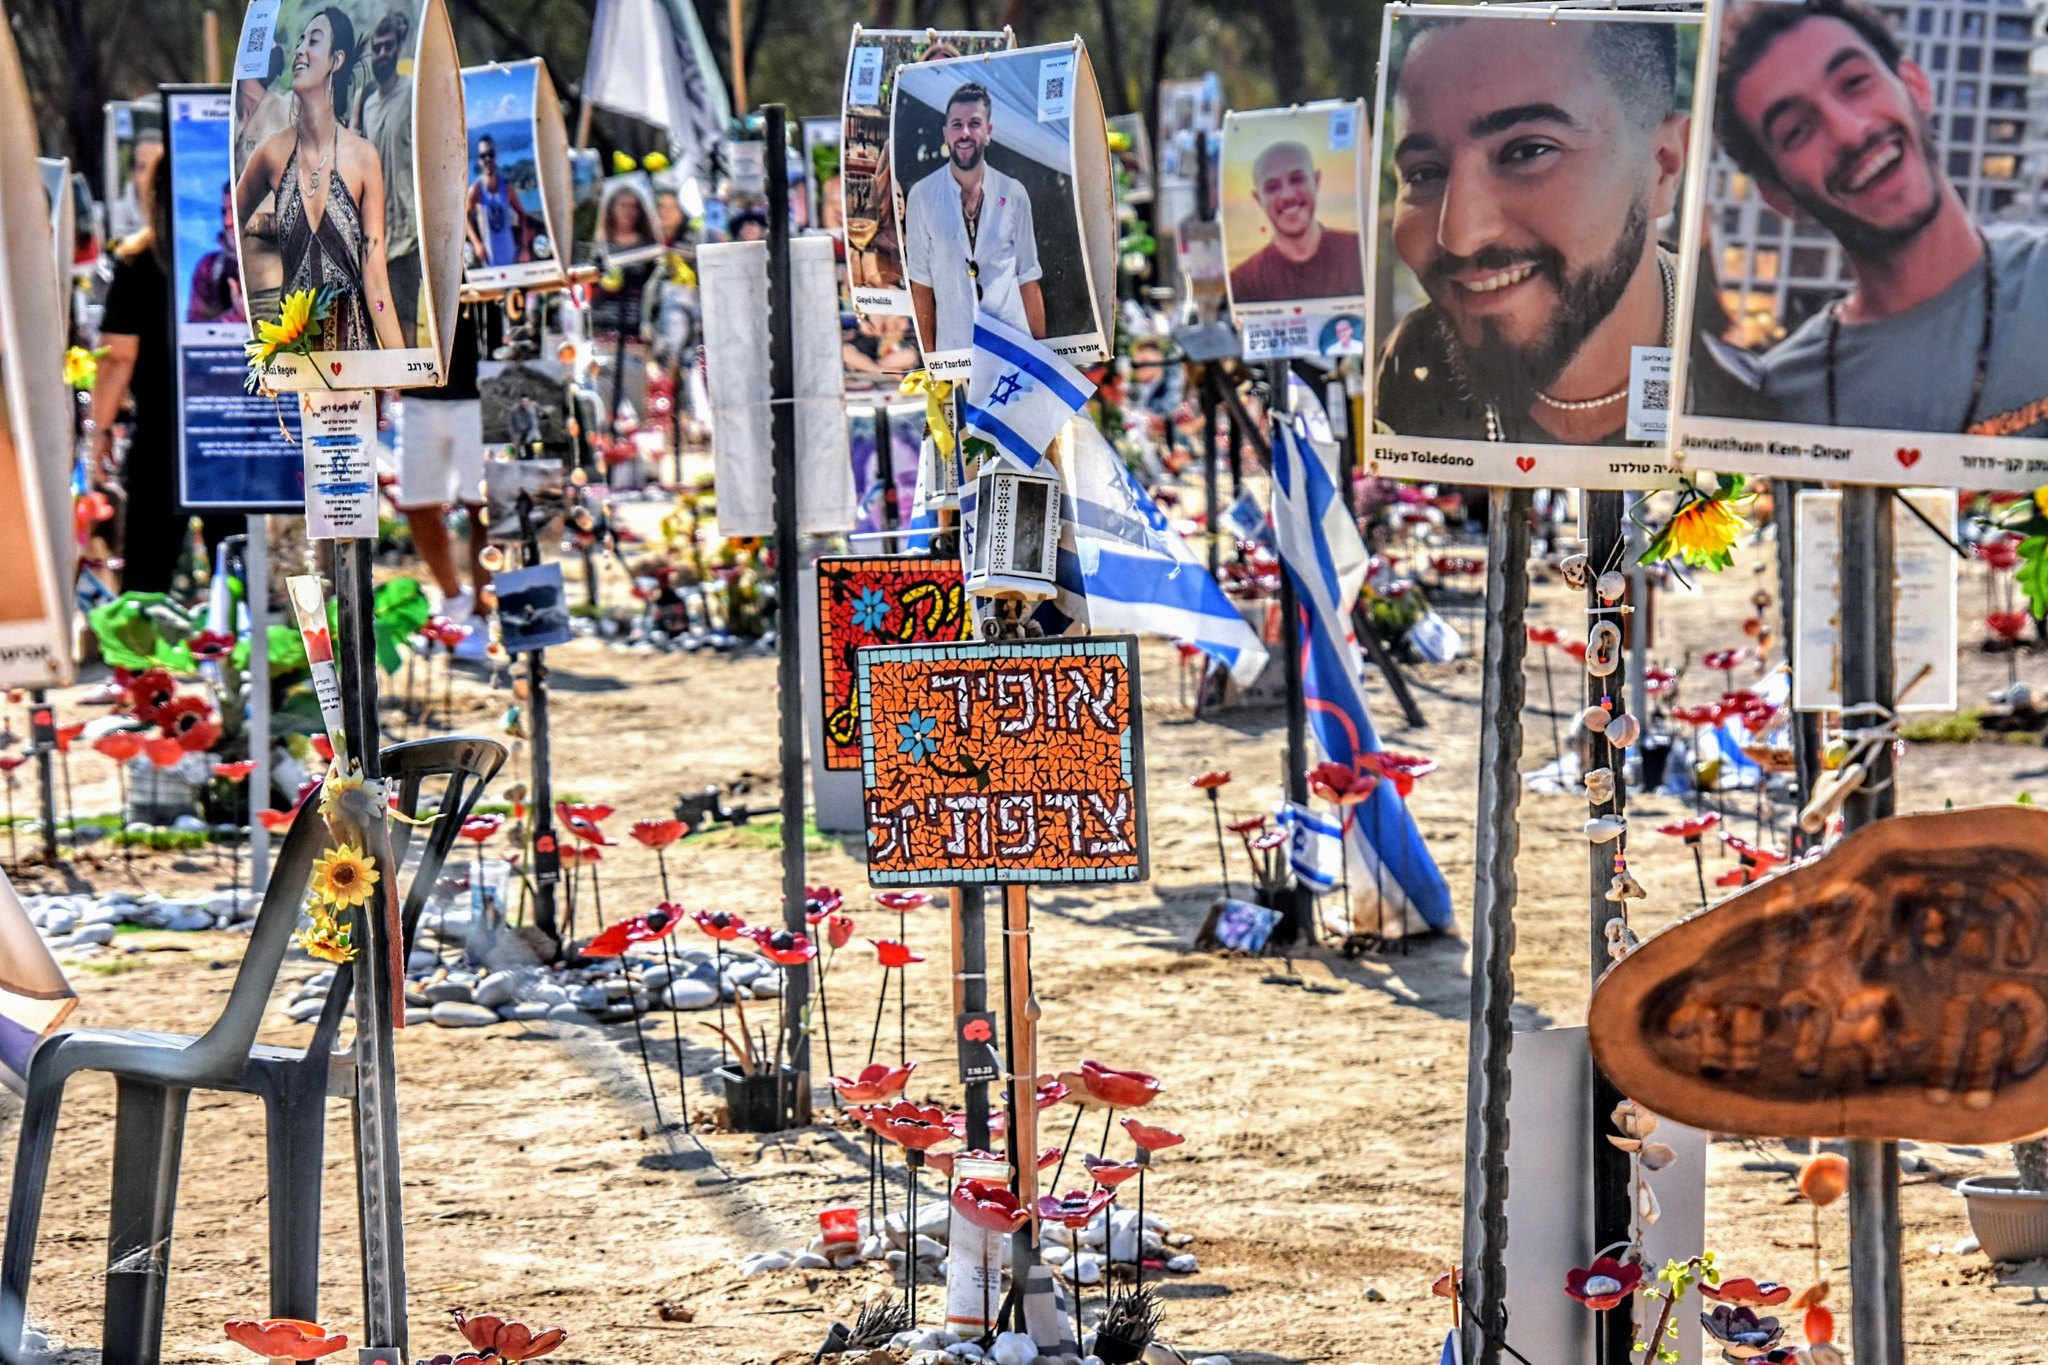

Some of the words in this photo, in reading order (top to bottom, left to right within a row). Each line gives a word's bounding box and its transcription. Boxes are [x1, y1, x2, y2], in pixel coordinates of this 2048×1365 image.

[1053, 346, 1077, 355] צרפתי
[1079, 343, 1100, 353] אופיר
[277, 365, 297, 378] Regev
[407, 362, 422, 371] רגב
[423, 362, 434, 370] שי
[1374, 448, 1409, 463] Eliya
[1410, 451, 1474, 466] Toledano
[1609, 462, 1650, 474] טולדנו
[927, 665, 1120, 738] אופיר
[926, 790, 1133, 859] צרפתי
